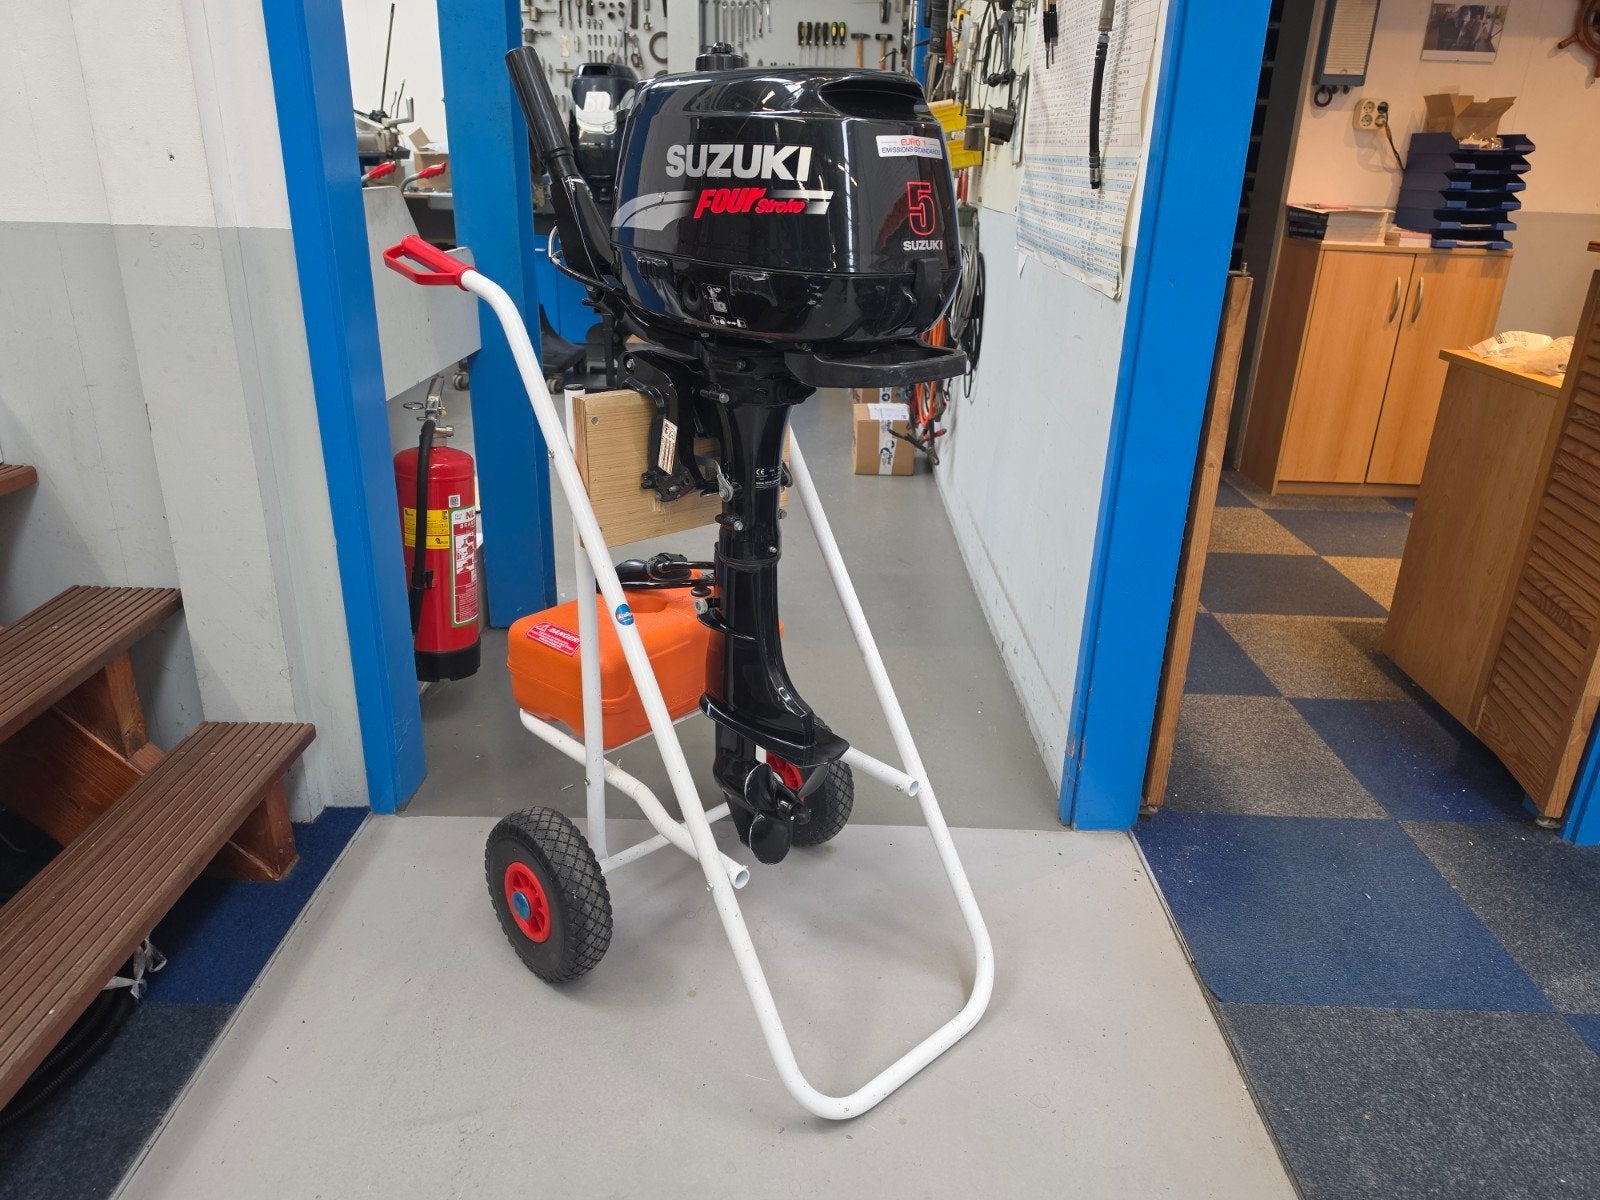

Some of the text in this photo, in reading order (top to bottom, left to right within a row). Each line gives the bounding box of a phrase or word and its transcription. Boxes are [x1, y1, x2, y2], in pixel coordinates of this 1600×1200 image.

[900, 138, 921, 147] EURO
[881, 146, 914, 154] EMISSIONS
[665, 144, 813, 182] SUZUKI
[754, 198, 806, 214] Stroke
[907, 181, 936, 236] 5
[903, 240, 943, 251] SUZUKI
